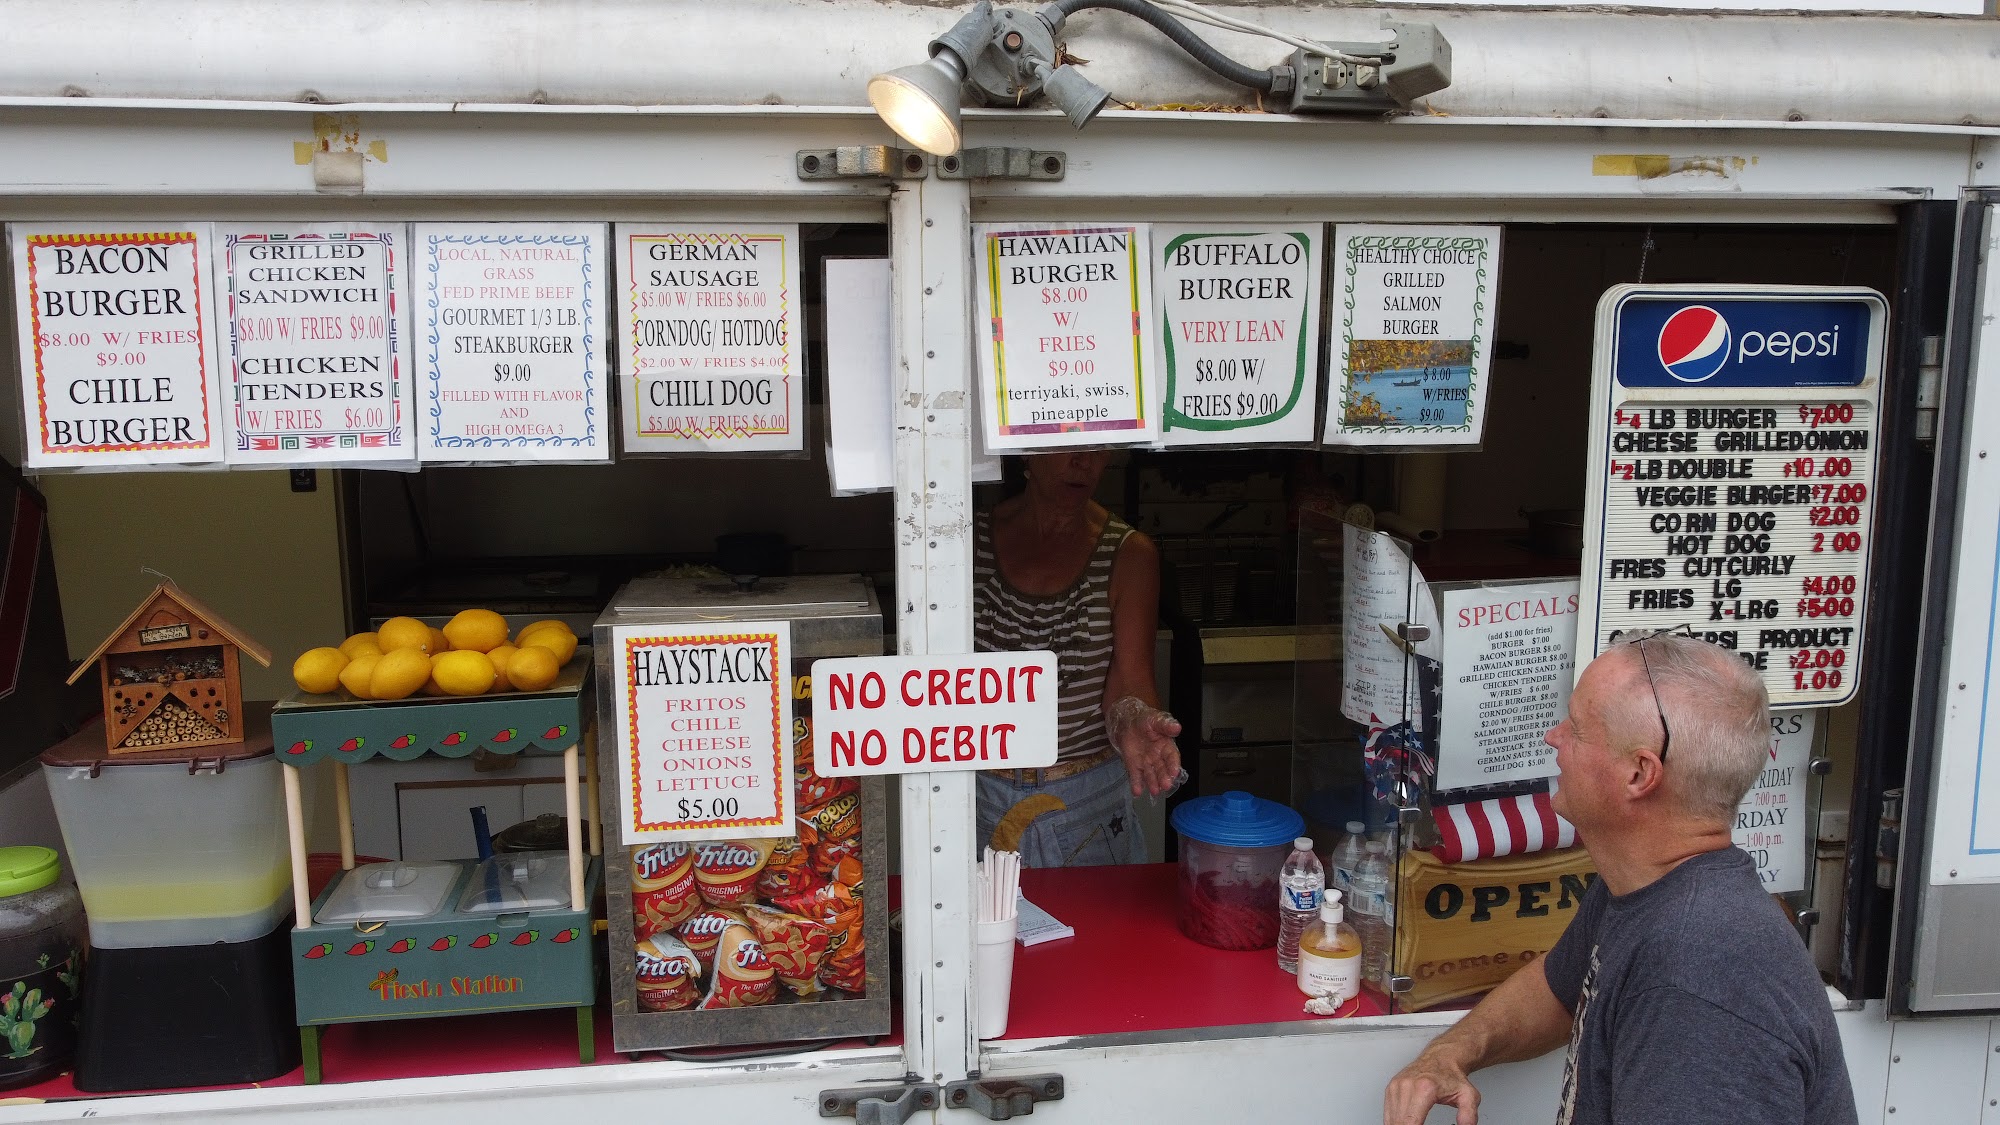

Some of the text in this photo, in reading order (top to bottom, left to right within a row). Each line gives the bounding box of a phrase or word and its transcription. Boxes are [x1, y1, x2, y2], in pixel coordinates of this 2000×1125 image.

[249, 245, 365, 260] GRILLED
[649, 245, 758, 261] GERMAN
[999, 234, 1128, 257] HAWAIIAN
[54, 246, 170, 275] BACON
[439, 249, 579, 262] LOCAL, NATURAL,
[1175, 243, 1301, 267] BUFFALO
[1355, 248, 1475, 264] HEALTHY CHOICE
[249, 266, 366, 282] CHICKEN
[483, 268, 535, 280] GRASS
[650, 270, 759, 287] SAUSAGE
[1011, 263, 1118, 285] BURGER
[1383, 272, 1445, 288] GRILLED
[239, 288, 378, 304] SANDWICH
[443, 287, 575, 299] FED PRIME BEEF
[1041, 286, 1088, 304] $8.00
[1179, 277, 1294, 301] BURGER
[42, 288, 187, 317] BURGER
[641, 291, 767, 310] $5.00 W/ FRIES $6.00
[1383, 296, 1442, 311] SALMON
[443, 308, 581, 329] GOURMET 1/3 LB.
[1053, 312, 1079, 330] W/
[1383, 320, 1439, 335] BURGER
[239, 313, 384, 345] $8.00 W/ FRIES $9.00
[635, 319, 787, 352] CORNDOG/ HOTDOG
[1181, 319, 1286, 343] VERY LEAN
[40, 330, 197, 348] $8.00 W/ FRIES
[454, 336, 574, 353] STEAKBURGER
[1039, 335, 1096, 353] FRIES
[1738, 324, 1839, 364] pepsi
[97, 352, 146, 367] $9.00
[240, 356, 380, 375] CHICKEN
[640, 357, 784, 369] $2.00 W/ FRIES $4.00
[1049, 360, 1095, 377] $9.00
[494, 362, 531, 383] $9.00
[1196, 357, 1265, 385] $8.00 W/
[69, 377, 174, 404] CHILE
[242, 381, 384, 400] TENDERS
[442, 391, 583, 401] FILLED WITH FLAVOR
[650, 379, 773, 407] CHILI DOG
[1009, 383, 1130, 402] terriyaki, swiss,
[500, 408, 529, 418] AND
[1183, 391, 1278, 417] FRIES $9.00
[247, 406, 383, 434] W/ FRIES $6.00
[1031, 404, 1109, 423] pineapple
[1420, 408, 1444, 422] $9.00
[1649, 408, 1676, 430] LB
[1686, 408, 1777, 429] BURGER
[1799, 403, 1853, 428] $7.00
[51, 416, 196, 445] BURGER
[466, 425, 564, 435] HIGH OMEGA 3
[649, 415, 785, 431] $5.00 W/ FRIES $6.00
[1613, 431, 1698, 452] CHEESE
[1634, 459, 1662, 480] LB
[1668, 458, 1753, 479] DOUBLE
[1636, 482, 1866, 506] VEGGIE BURGER $7.00
[1650, 506, 1860, 534] CORN DOG $2.00
[1667, 534, 1771, 556] HOT DOG
[1610, 558, 1666, 578] FRES
[1713, 575, 1856, 599] LG $4.00
[1628, 589, 1694, 610] FRIES
[1458, 594, 1579, 628] SPECIALS
[1491, 640, 1524, 650] BURGER
[1759, 627, 1854, 649] PRODUCT
[1480, 646, 1541, 661] BACON BURGER
[1790, 649, 1846, 669] $2.00
[633, 647, 771, 686] HAYSTACK
[1473, 656, 1547, 672] HAWAIIAN BURGER
[1460, 667, 1533, 683] GRILLED CHICKEN
[1483, 674, 1557, 690] CHICKEN TENDERS
[1794, 670, 1842, 690] 1.00
[829, 672, 886, 710] NO
[901, 665, 1043, 707] CREDIT
[665, 697, 746, 712] FRITOS
[1480, 696, 1536, 709] CHILE BURGER
[1480, 707, 1518, 718] CORNDOG
[1513, 714, 1534, 722] FRIES
[671, 717, 741, 732] CHILE
[1474, 722, 1540, 738] SALMON BURGER
[662, 736, 751, 752] CHEESE
[831, 729, 887, 767] NO
[903, 724, 1016, 764] DEBIT
[1479, 732, 1534, 746] STEAKBURGER
[1485, 742, 1524, 755] HAYSTACK
[663, 756, 752, 771] ONIONS
[1477, 754, 1512, 765] GERMAN
[1484, 761, 1524, 773] CHILI DOG
[656, 775, 761, 792] LETTUCE
[678, 797, 739, 821] $5.00
[694, 842, 758, 868] Fritos
[1415, 950, 1507, 981] Come
[451, 975, 523, 996] Station
